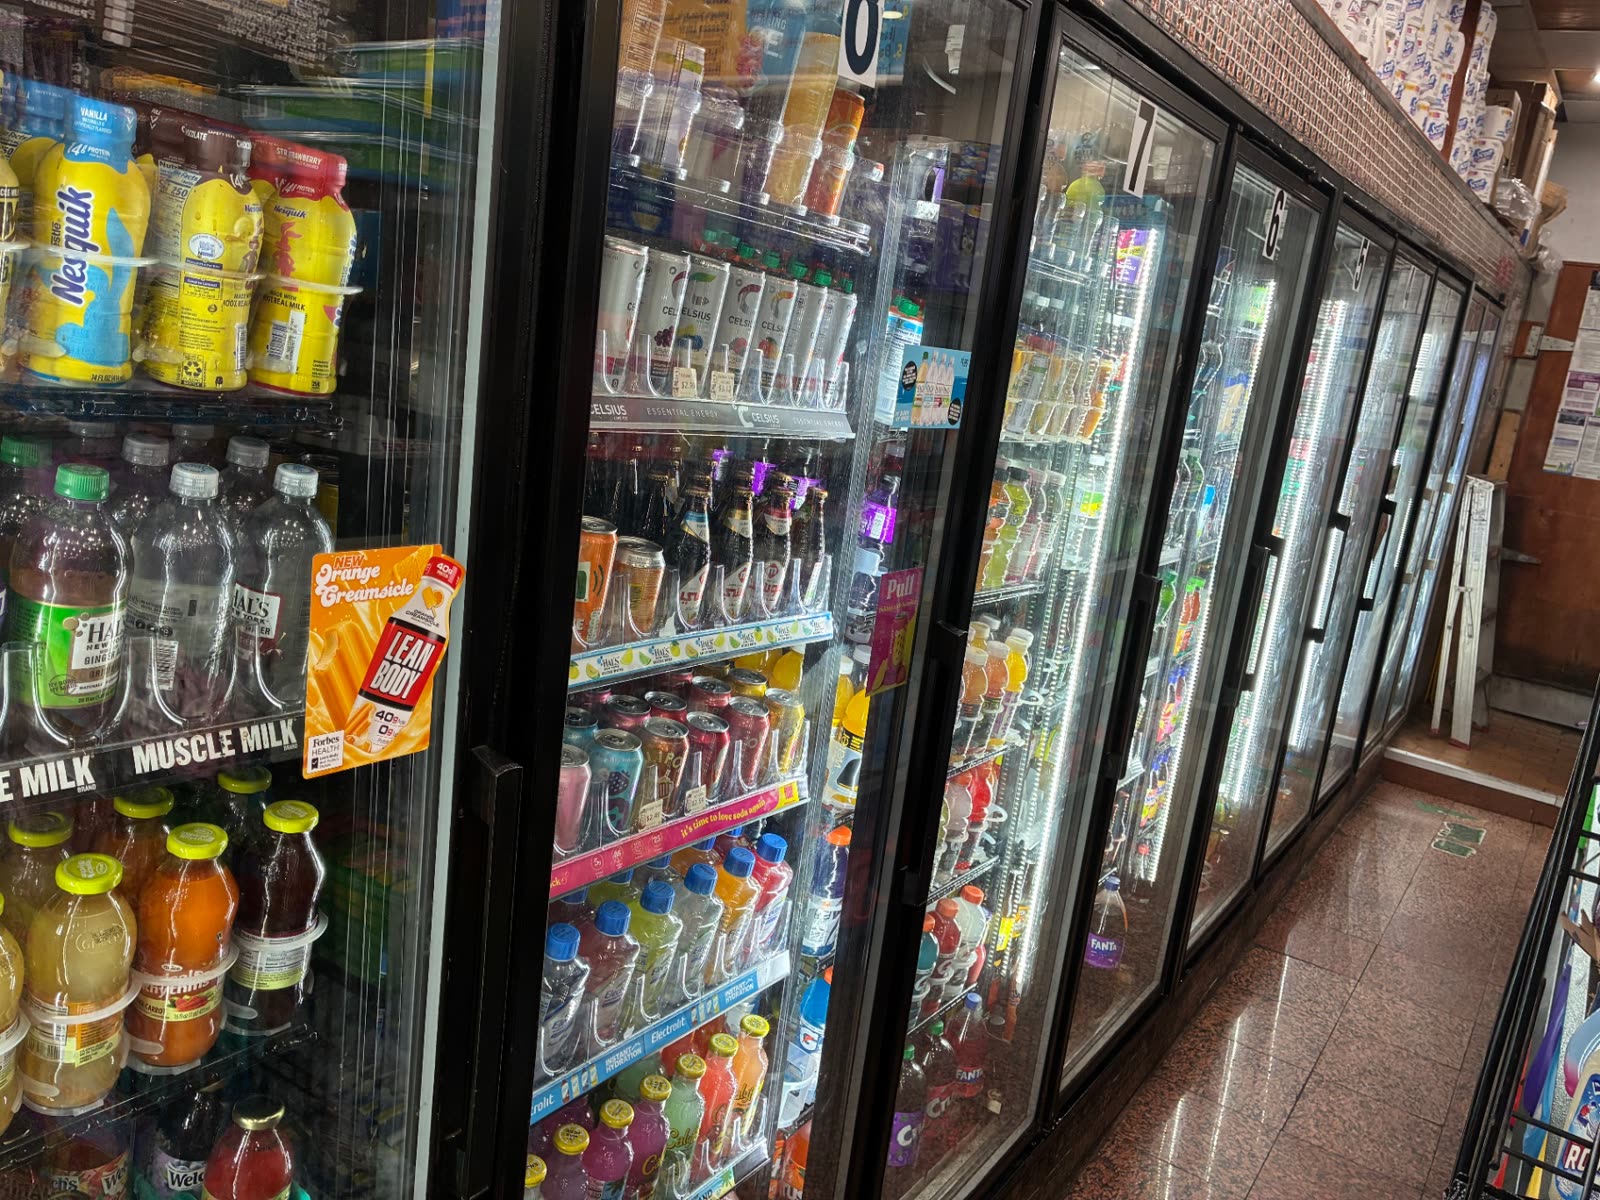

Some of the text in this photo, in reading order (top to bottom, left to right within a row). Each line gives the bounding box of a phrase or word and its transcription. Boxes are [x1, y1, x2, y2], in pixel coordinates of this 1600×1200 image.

[80, 107, 108, 122] VANILLA
[87, 146, 111, 158] PROTEIN
[1128, 99, 1156, 193] 7
[170, 187, 190, 199] 250
[273, 204, 307, 219] Nesquik
[1266, 190, 1285, 258] 6
[52, 186, 101, 305] Nesquik
[284, 293, 297, 302] WITH
[289, 301, 306, 312] MILK
[646, 406, 690, 418] ESSENTIAL
[690, 408, 720, 418] ENERGY
[751, 412, 780, 425] CELSIUS
[333, 555, 366, 570] NEW
[436, 562, 454, 576] 40g
[315, 563, 381, 586] Orange
[315, 578, 415, 608] Creamsicle
[886, 574, 915, 600] Pull
[384, 631, 437, 673] LEAN
[653, 646, 670, 657] HAL'S
[603, 656, 620, 668] HAL'S
[369, 660, 422, 700] BODY
[375, 709, 399, 724] 40g
[378, 724, 394, 737] 0g
[132, 718, 299, 775] MUSCLE MILK
[312, 735, 341, 749] Forbes
[311, 744, 340, 757] HEALTH
[19, 755, 97, 798] MILK
[77, 784, 98, 794] BRAND
[680, 799, 767, 840] it's time to love soda again
[1091, 938, 1118, 952] FANTA
[725, 983, 755, 1004] HYDRATION
[144, 1002, 167, 1016] CARROT
[651, 1016, 686, 1044] Electrolit
[605, 1046, 632, 1065] INSTANT
[605, 1047, 642, 1075] HYDRATION
